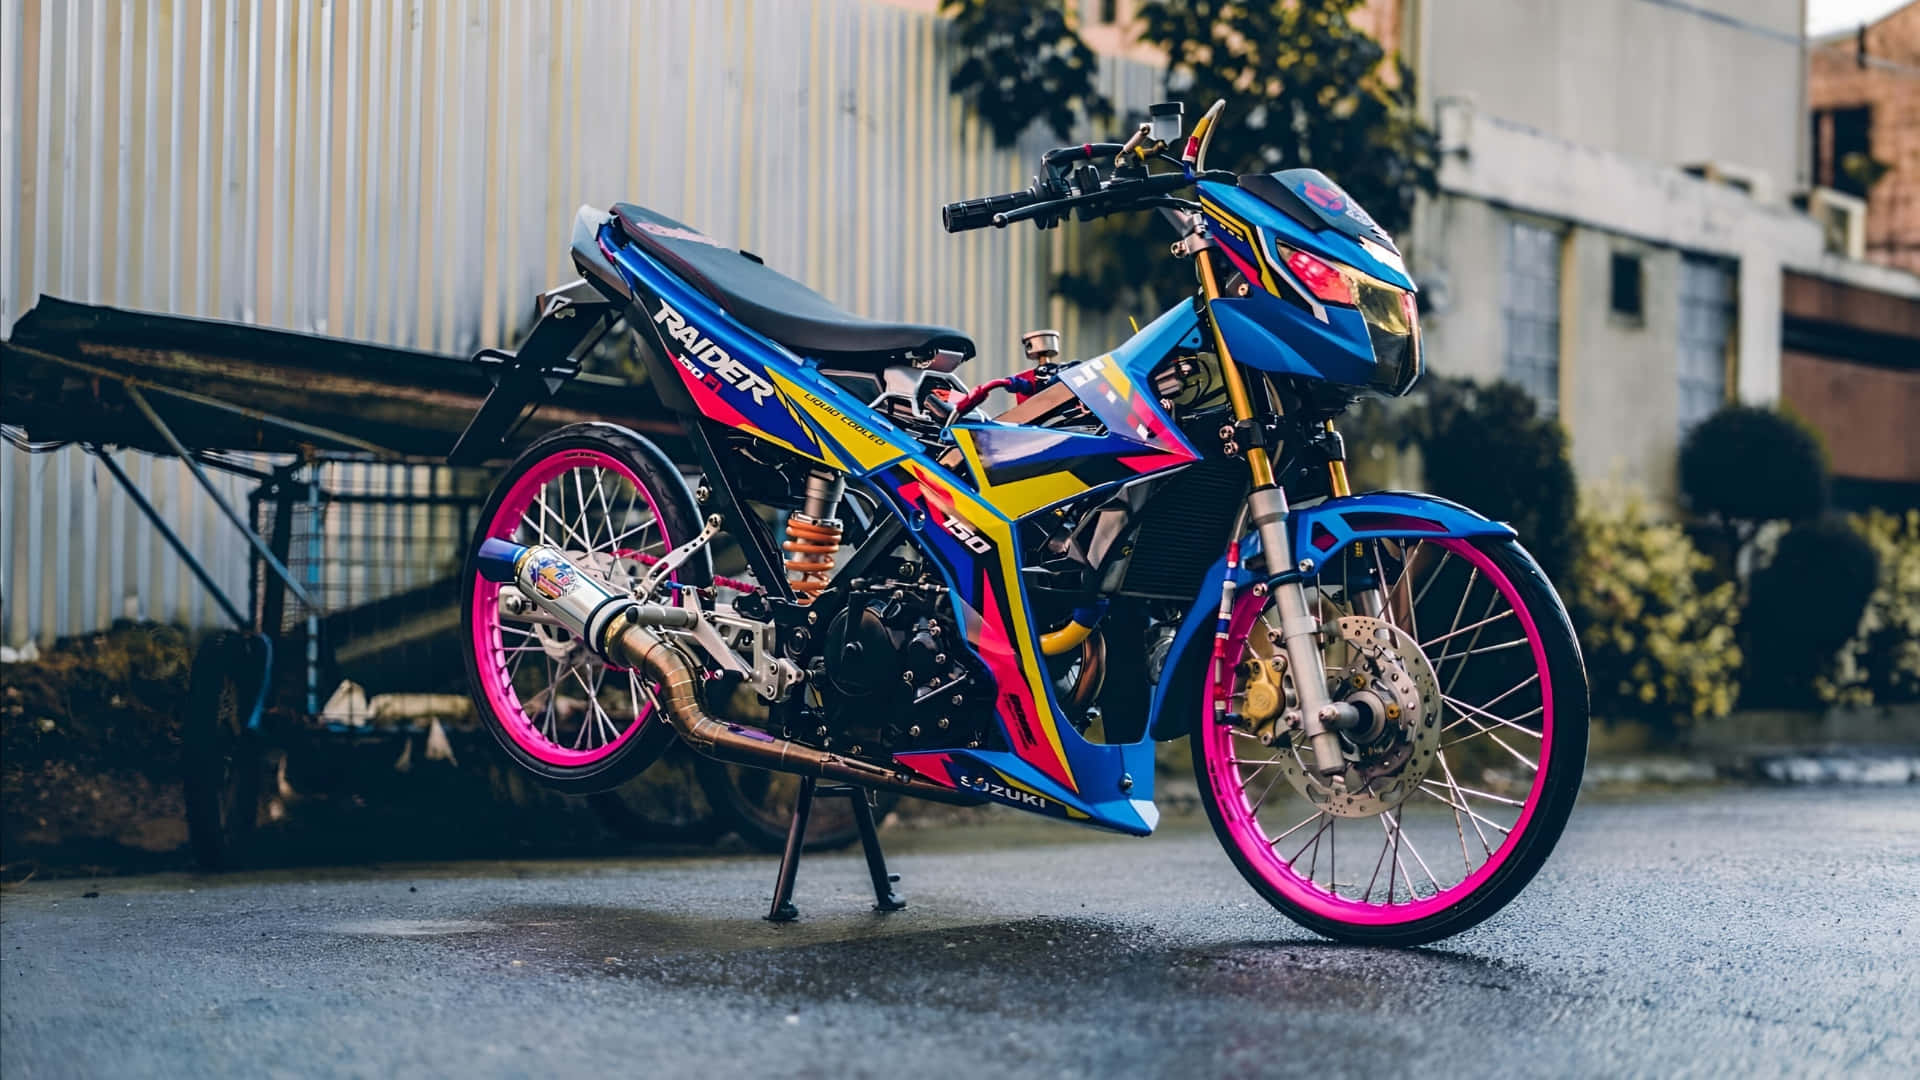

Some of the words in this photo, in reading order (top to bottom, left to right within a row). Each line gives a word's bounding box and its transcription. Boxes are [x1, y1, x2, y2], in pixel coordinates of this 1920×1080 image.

[654, 298, 775, 406] RAIDER
[804, 393, 840, 416] LIQUID
[841, 416, 886, 446] COOLED
[942, 515, 992, 554] 150
